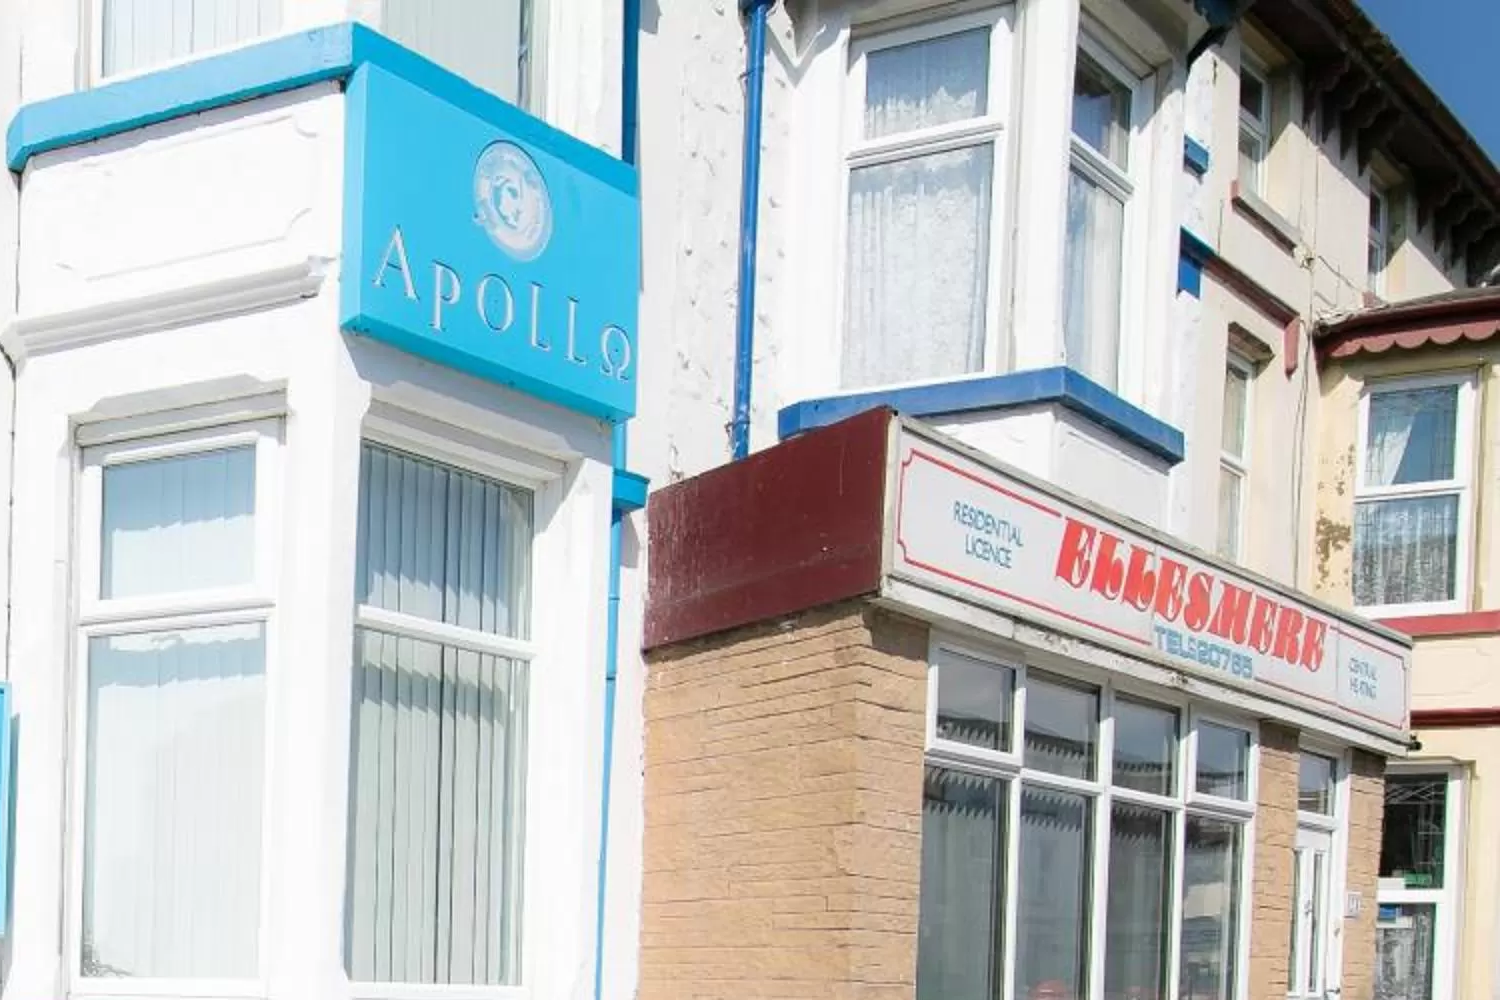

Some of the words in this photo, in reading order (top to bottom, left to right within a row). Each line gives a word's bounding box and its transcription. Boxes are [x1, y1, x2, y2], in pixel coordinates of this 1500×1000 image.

[953, 500, 1024, 547] RESIDENTIAL
[965, 533, 1013, 569] LICENCE
[1055, 516, 1327, 673] ELLESMERE
